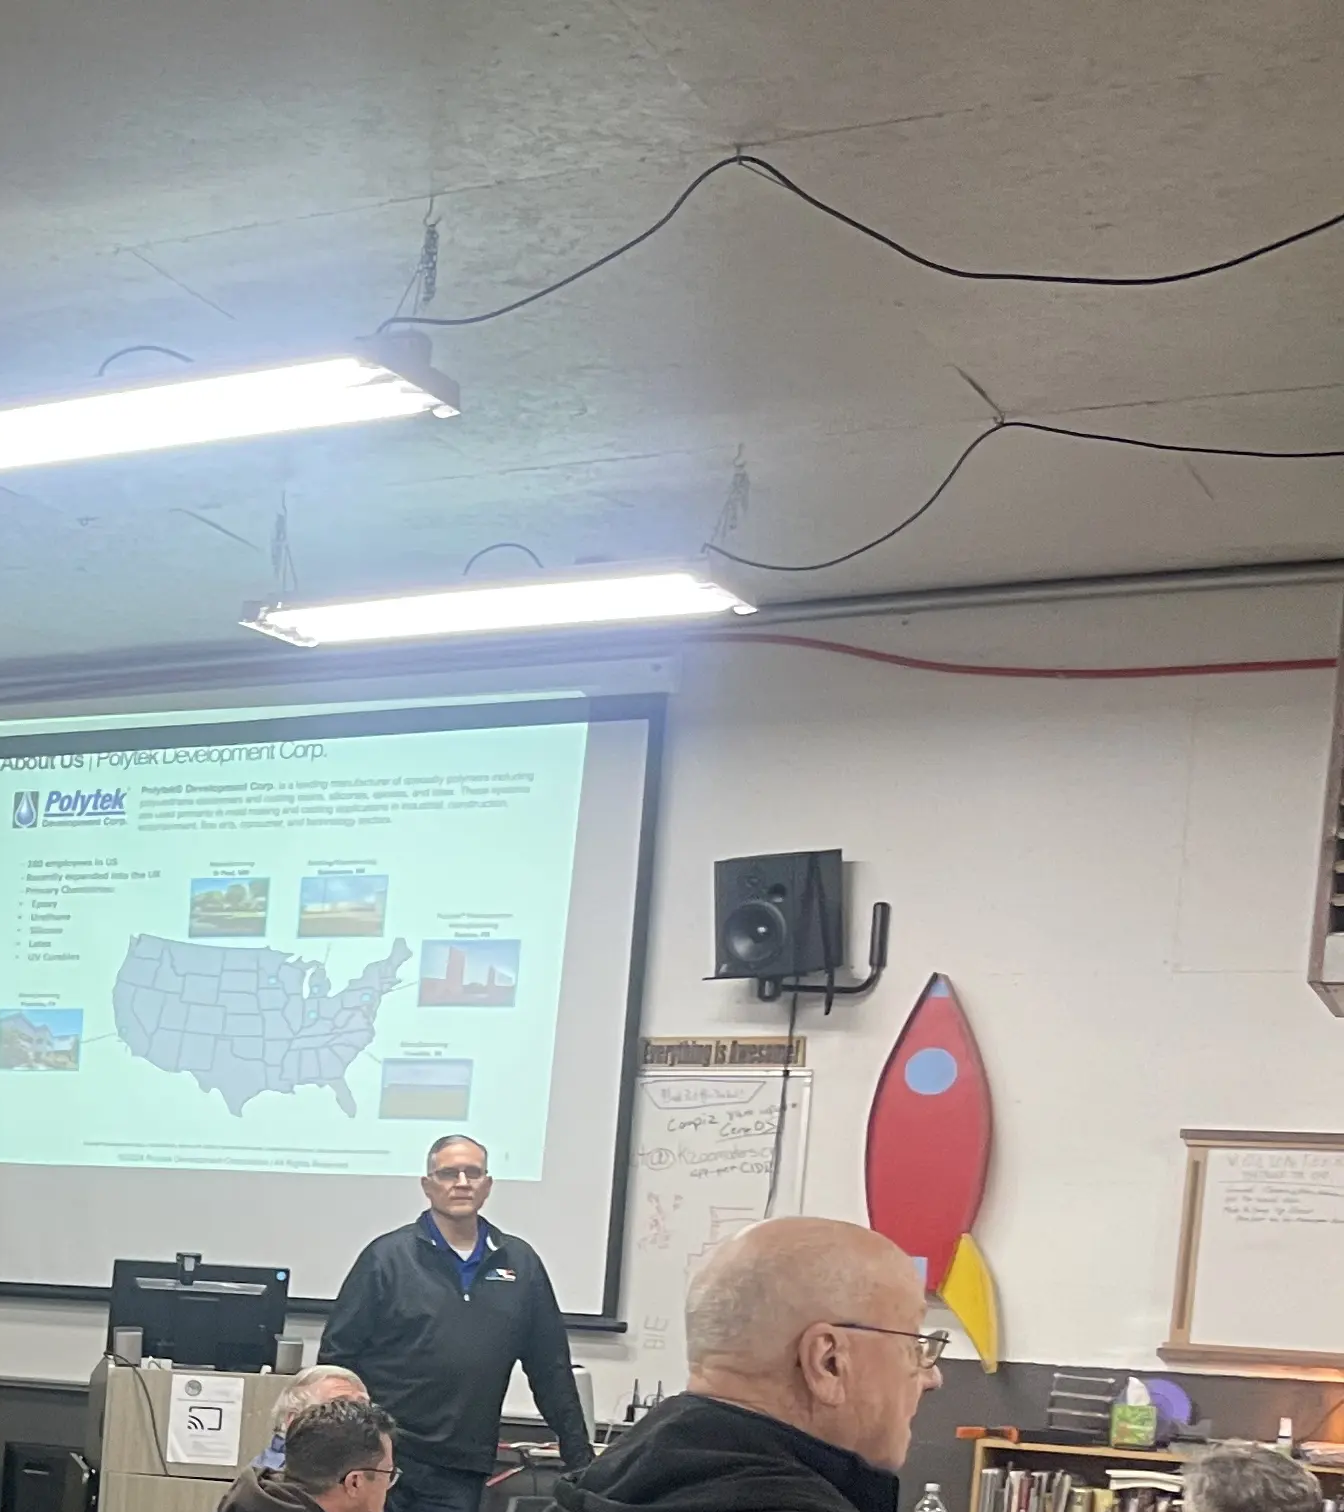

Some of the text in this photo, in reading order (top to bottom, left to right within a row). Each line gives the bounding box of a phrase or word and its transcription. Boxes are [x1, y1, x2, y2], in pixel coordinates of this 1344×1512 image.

[96, 750, 159, 771] Polytek
[163, 743, 277, 766] Development
[279, 742, 328, 762] Corp.
[44, 787, 128, 817] Polytek
